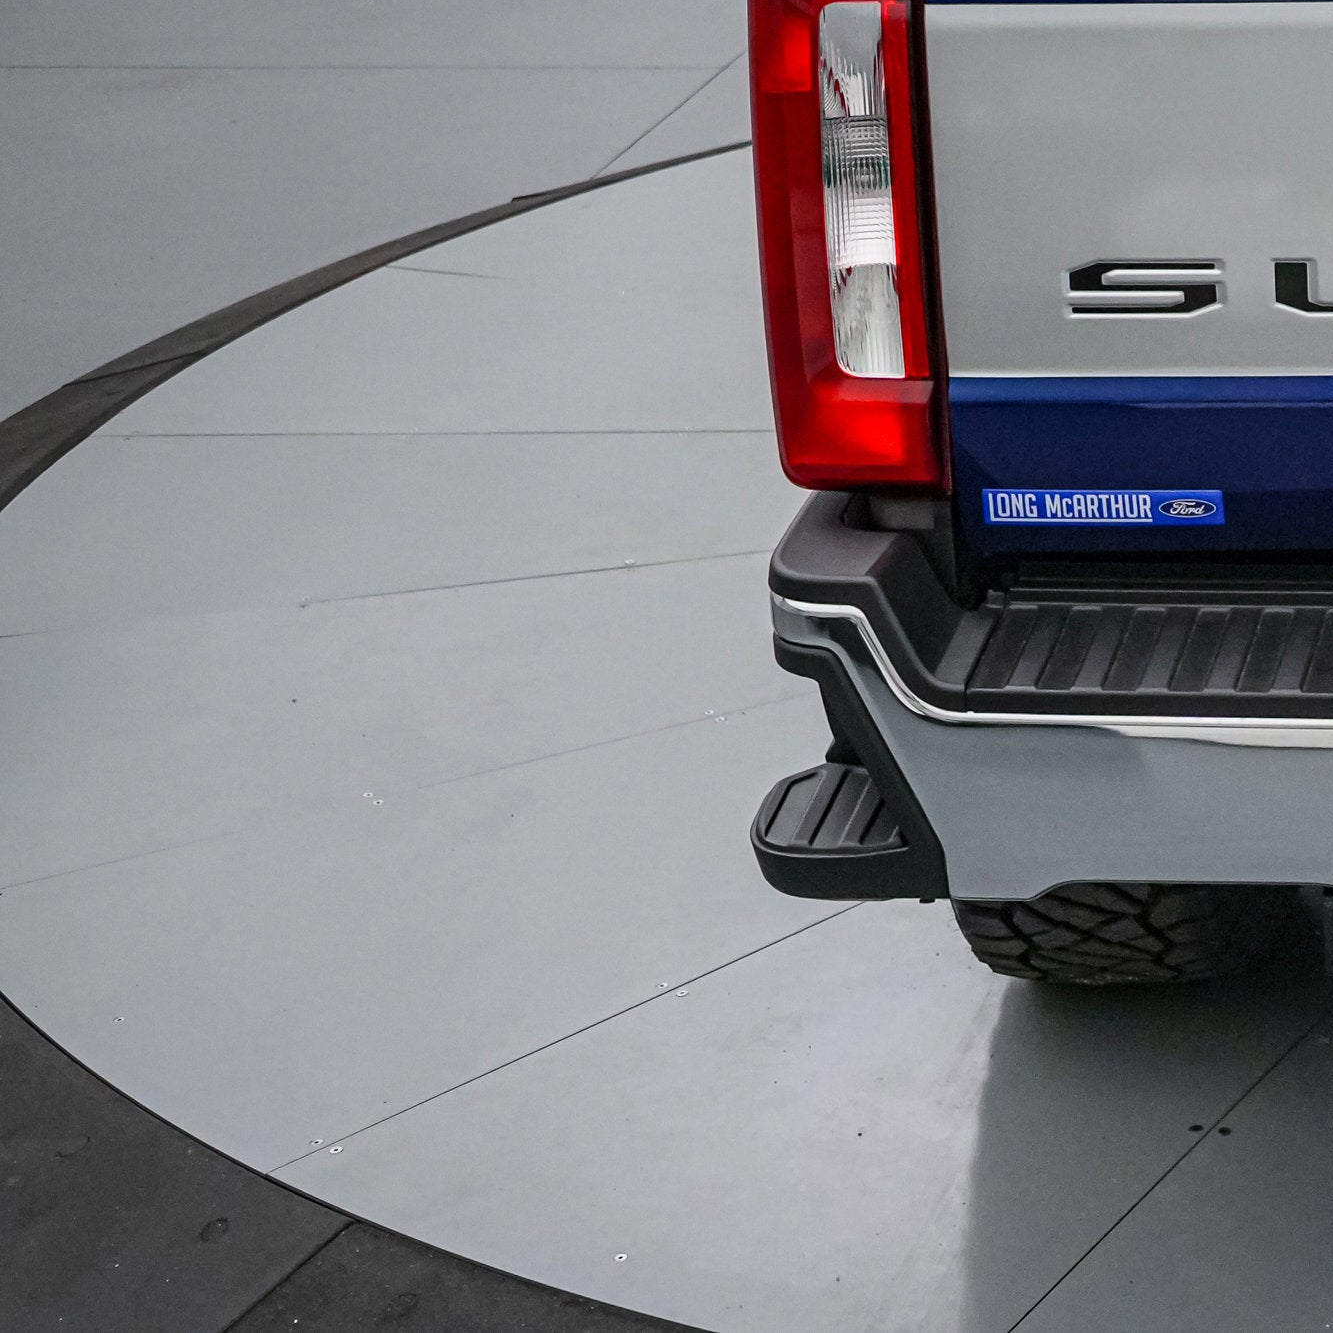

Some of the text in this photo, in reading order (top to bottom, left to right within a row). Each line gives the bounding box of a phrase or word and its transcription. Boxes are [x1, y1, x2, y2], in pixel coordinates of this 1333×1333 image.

[988, 493, 1153, 521] LONG McARTHUR
[1170, 502, 1206, 516] Ford
